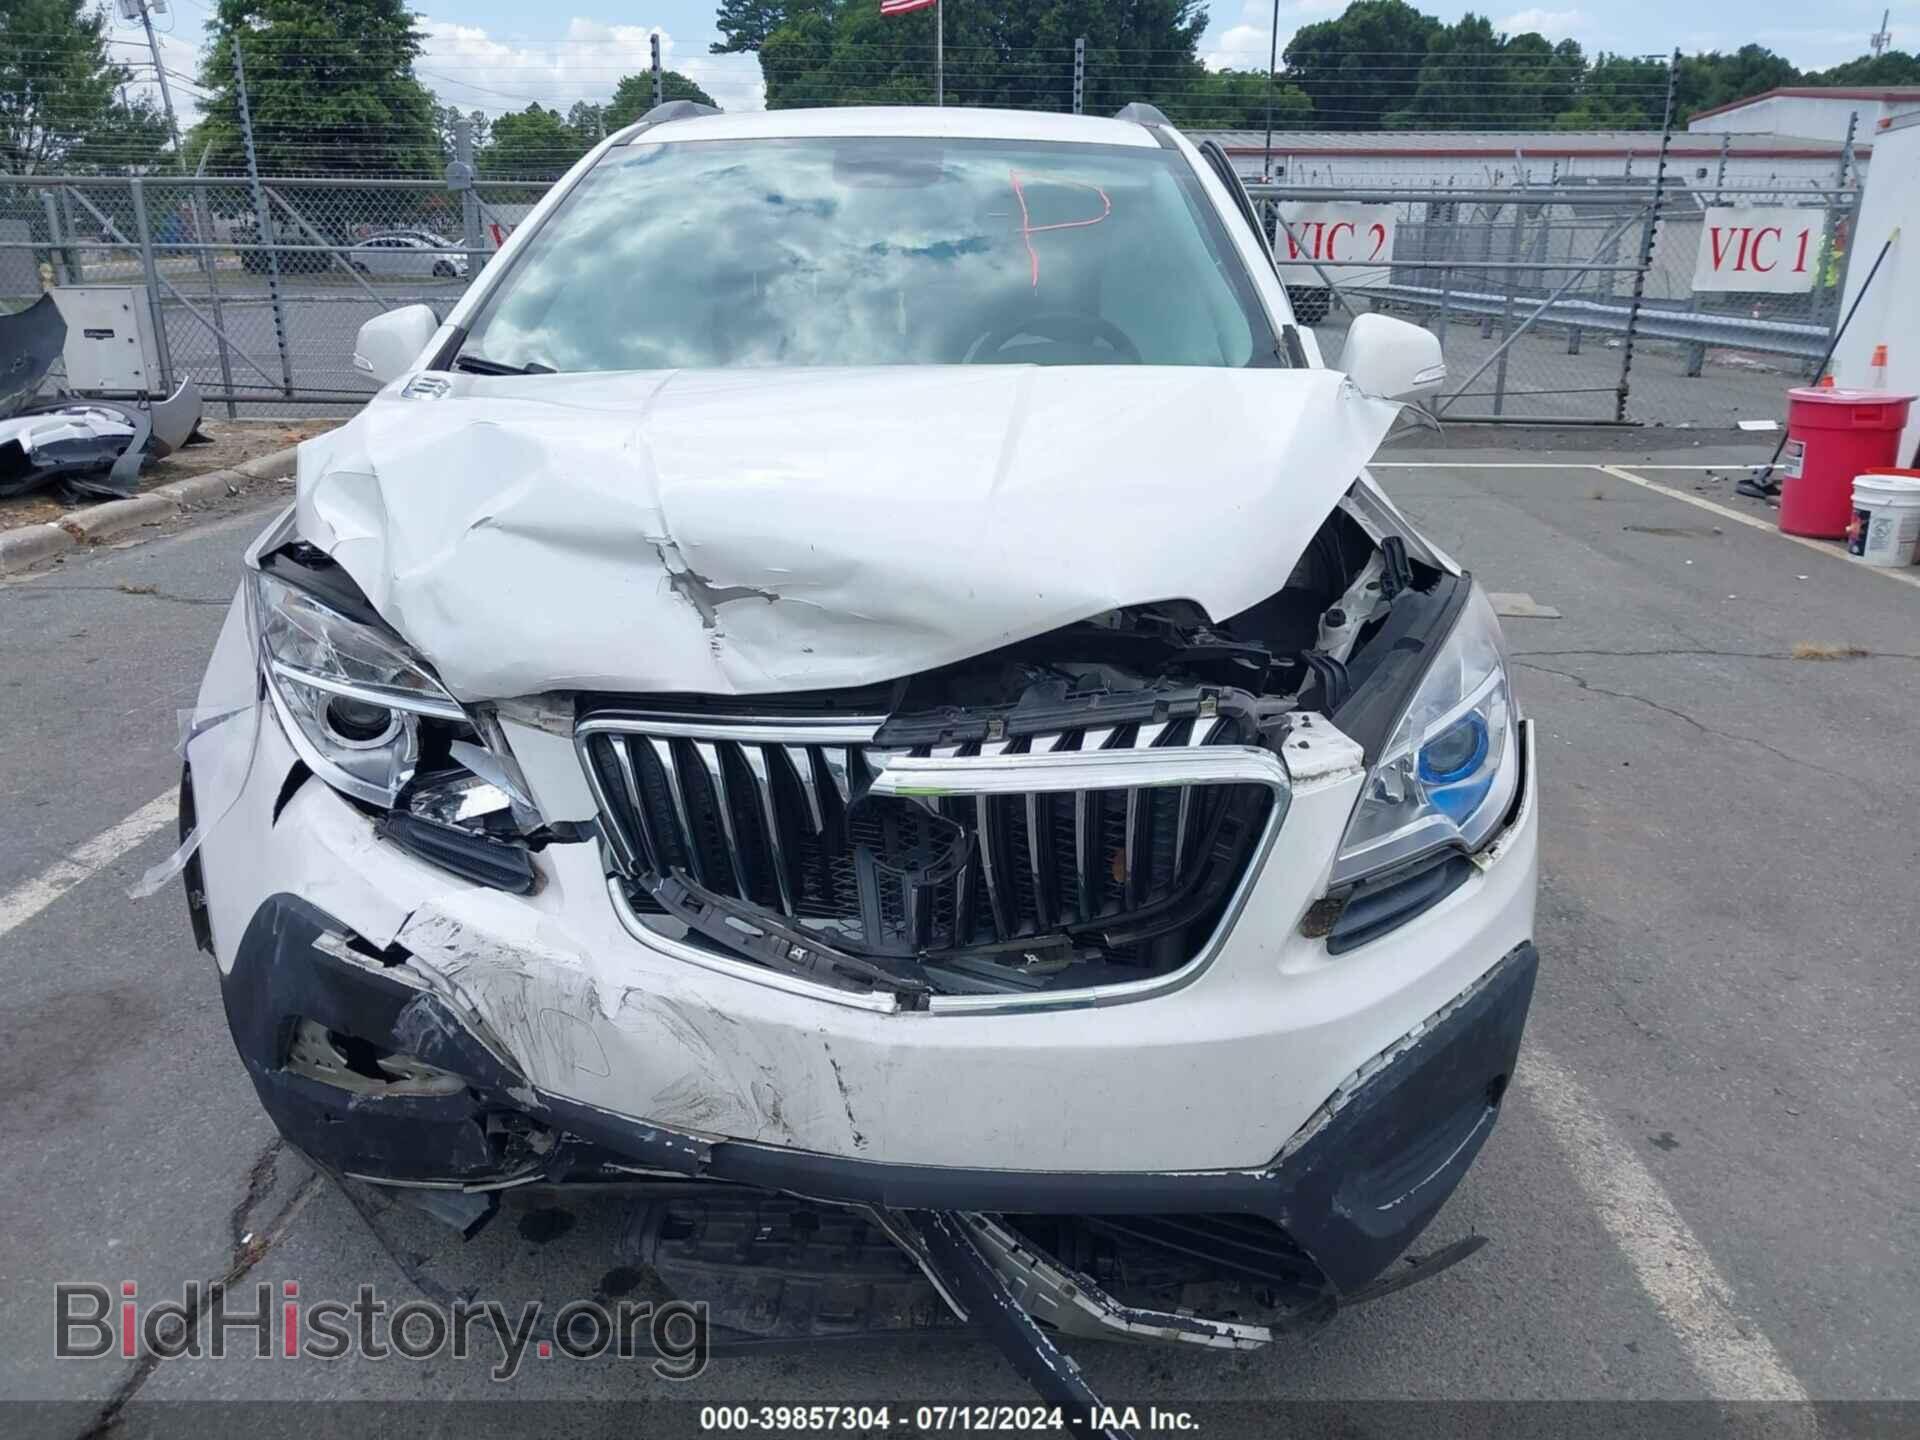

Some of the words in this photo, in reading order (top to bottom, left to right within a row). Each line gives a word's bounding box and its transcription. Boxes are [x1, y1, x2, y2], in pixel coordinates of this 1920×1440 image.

[1009, 169, 1111, 289] P
[1286, 222, 1355, 266] VIC
[1368, 223, 1386, 263] 2
[1710, 227, 1782, 272] VIC
[1792, 229, 1809, 272] 1
